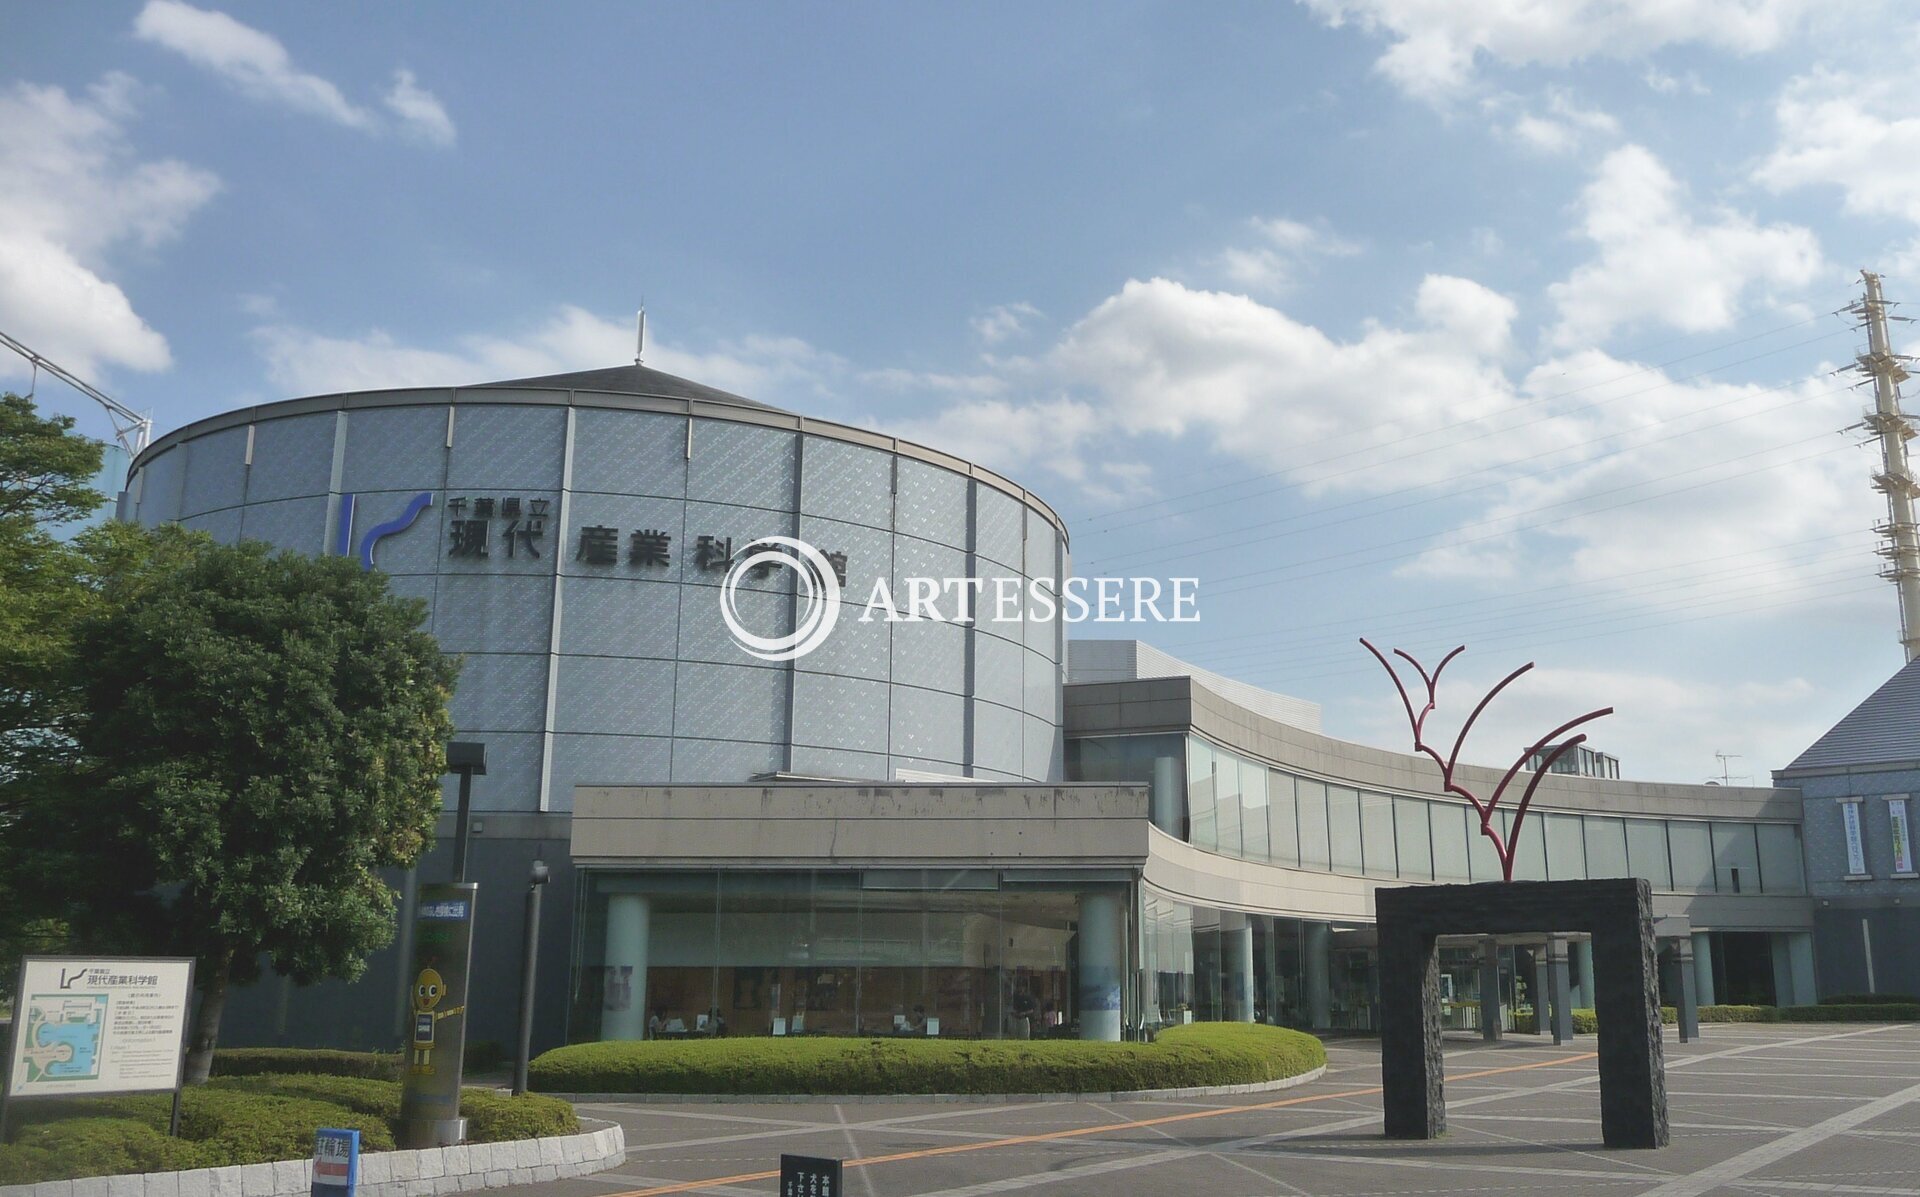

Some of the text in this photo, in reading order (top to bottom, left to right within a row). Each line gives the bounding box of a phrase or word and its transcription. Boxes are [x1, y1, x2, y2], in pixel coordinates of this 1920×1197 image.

[448, 497, 549, 517] 千葉県立
[87, 975, 158, 985] 現代産業科学館
[797, 1172, 805, 1197] 下さ
